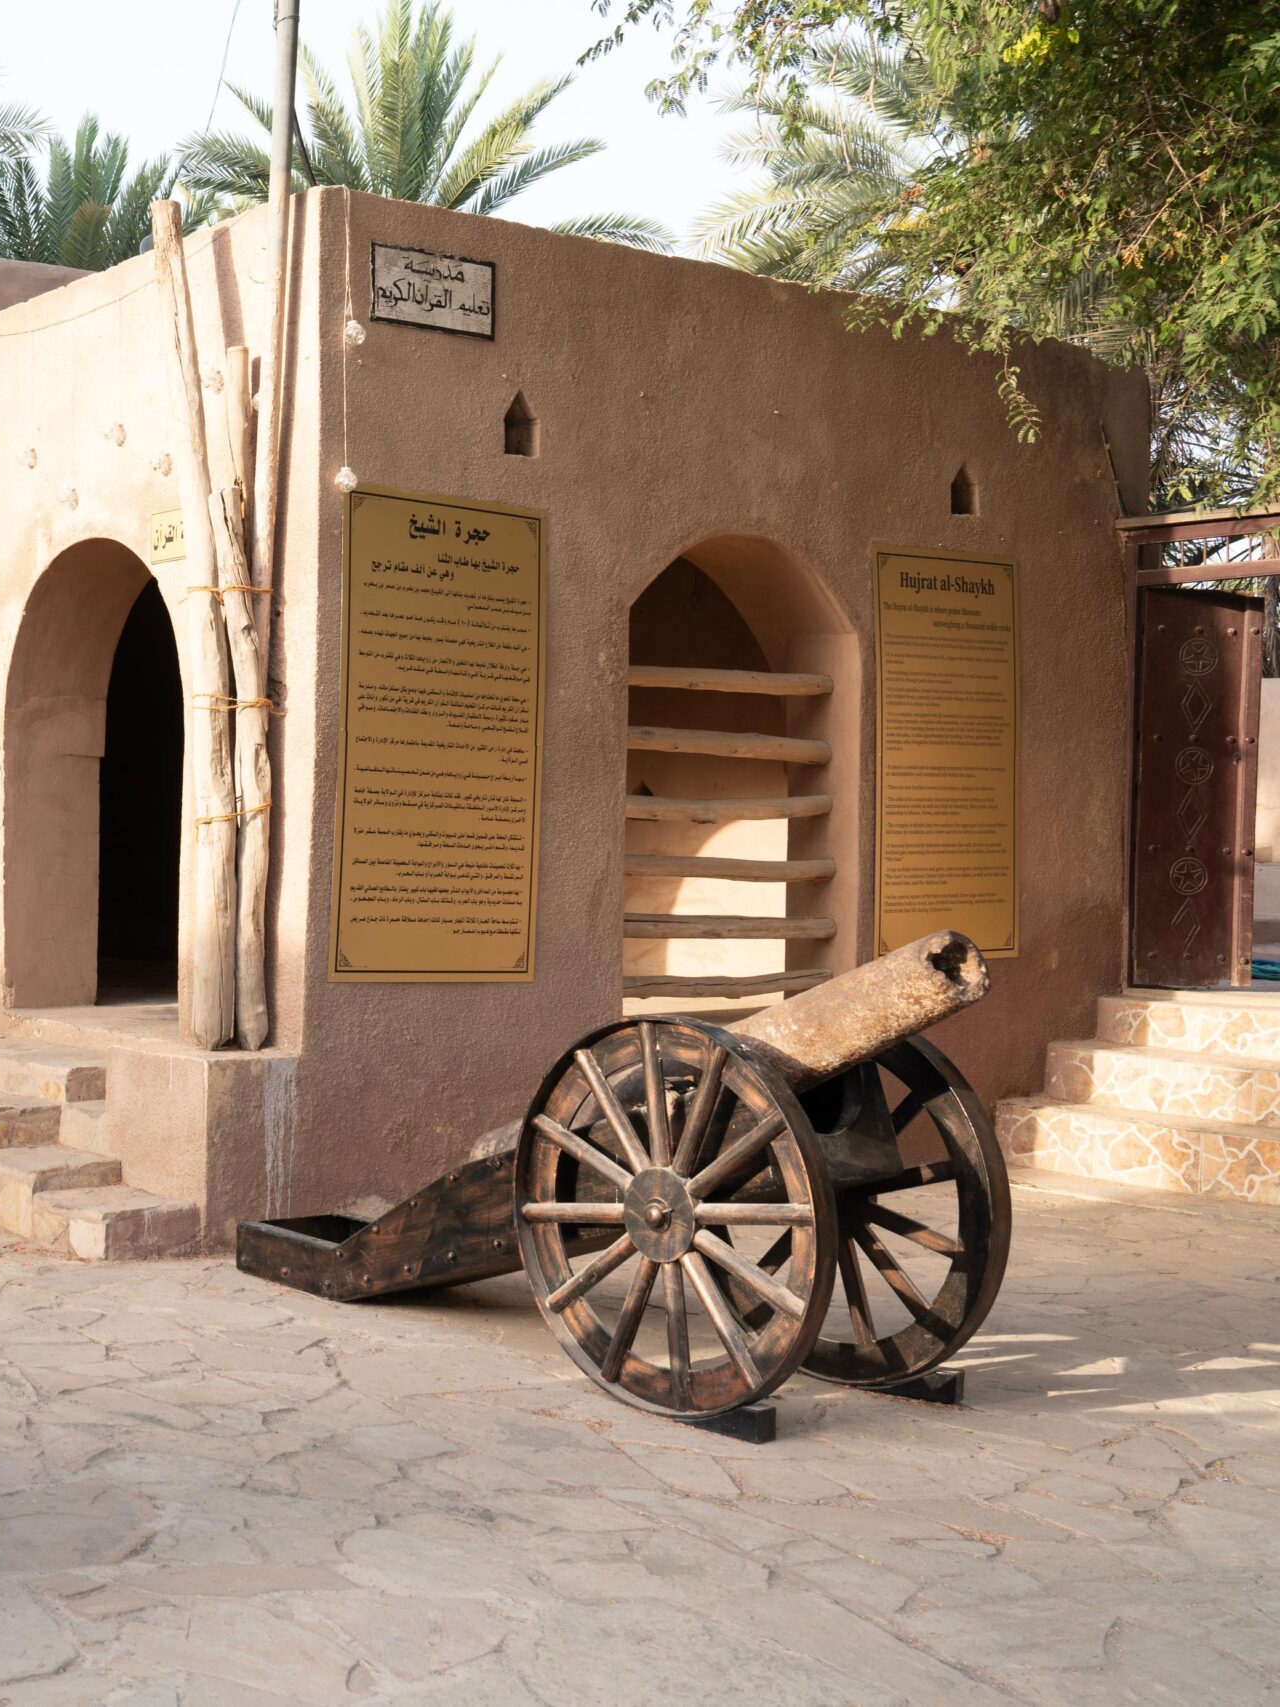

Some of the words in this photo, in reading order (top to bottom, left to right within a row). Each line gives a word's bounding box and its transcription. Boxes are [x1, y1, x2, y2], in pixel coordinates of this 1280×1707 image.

[402, 256, 465, 283] مدرسة
[377, 278, 415, 308] الكريم
[451, 293, 490, 316] تعليم
[408, 513, 446, 539] الشيخ
[455, 519, 491, 545] حجرة
[394, 561, 408, 573] مقام
[426, 566, 437, 578] عن
[470, 557, 481, 571] بها
[481, 557, 501, 572] الشيخ
[501, 561, 520, 575] حجرة
[439, 568, 455, 581] وهي
[900, 571, 938, 594] Hujrat
[940, 574, 996, 598] al-Shaykh
